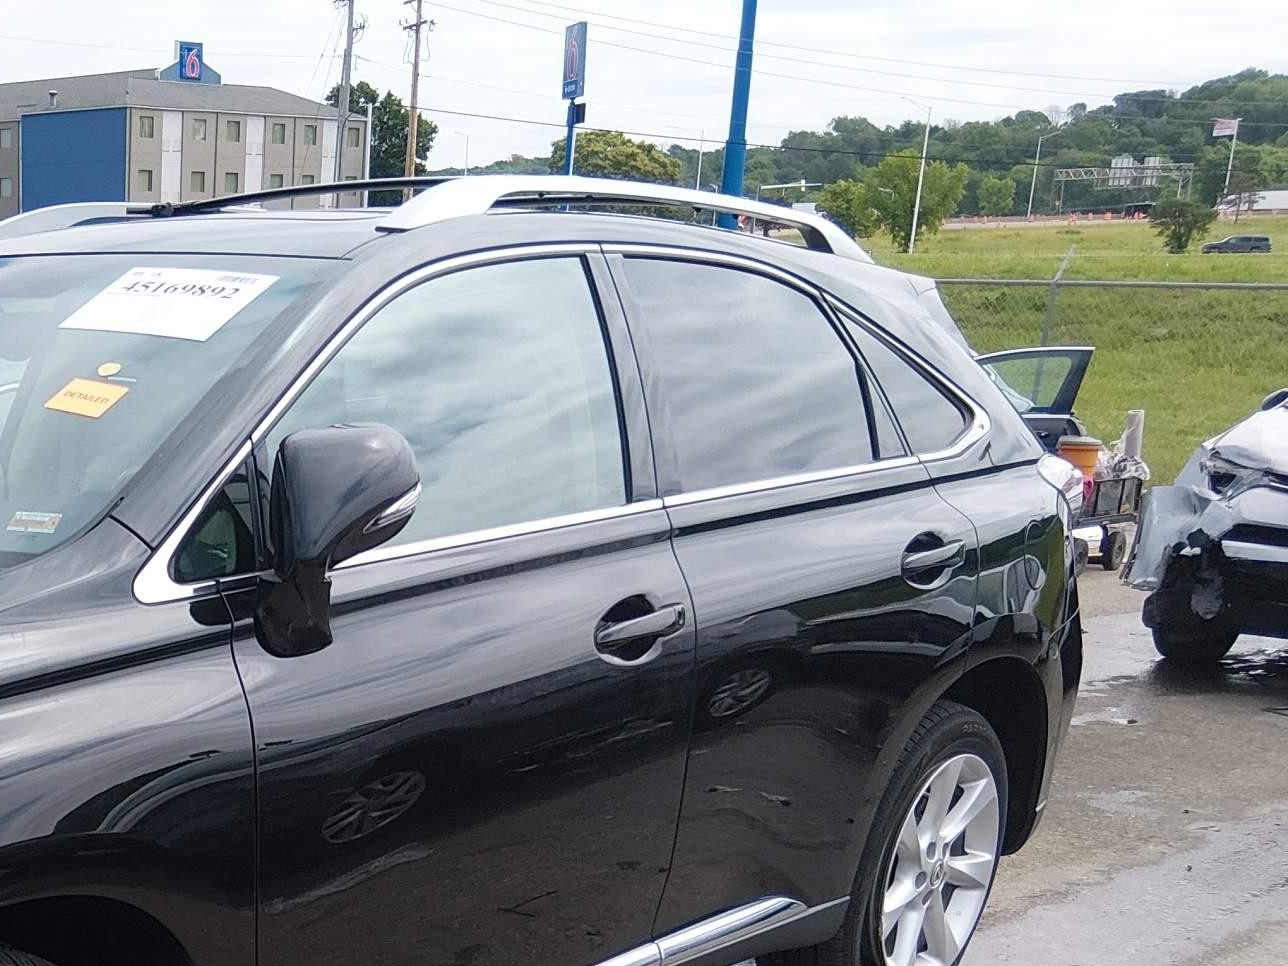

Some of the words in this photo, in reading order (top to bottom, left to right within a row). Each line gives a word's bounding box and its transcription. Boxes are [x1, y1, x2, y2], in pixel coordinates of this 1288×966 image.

[186, 48, 200, 78] 6
[567, 28, 579, 81] 6
[121, 280, 241, 299] 45169892
[63, 389, 110, 405] DETAILED
